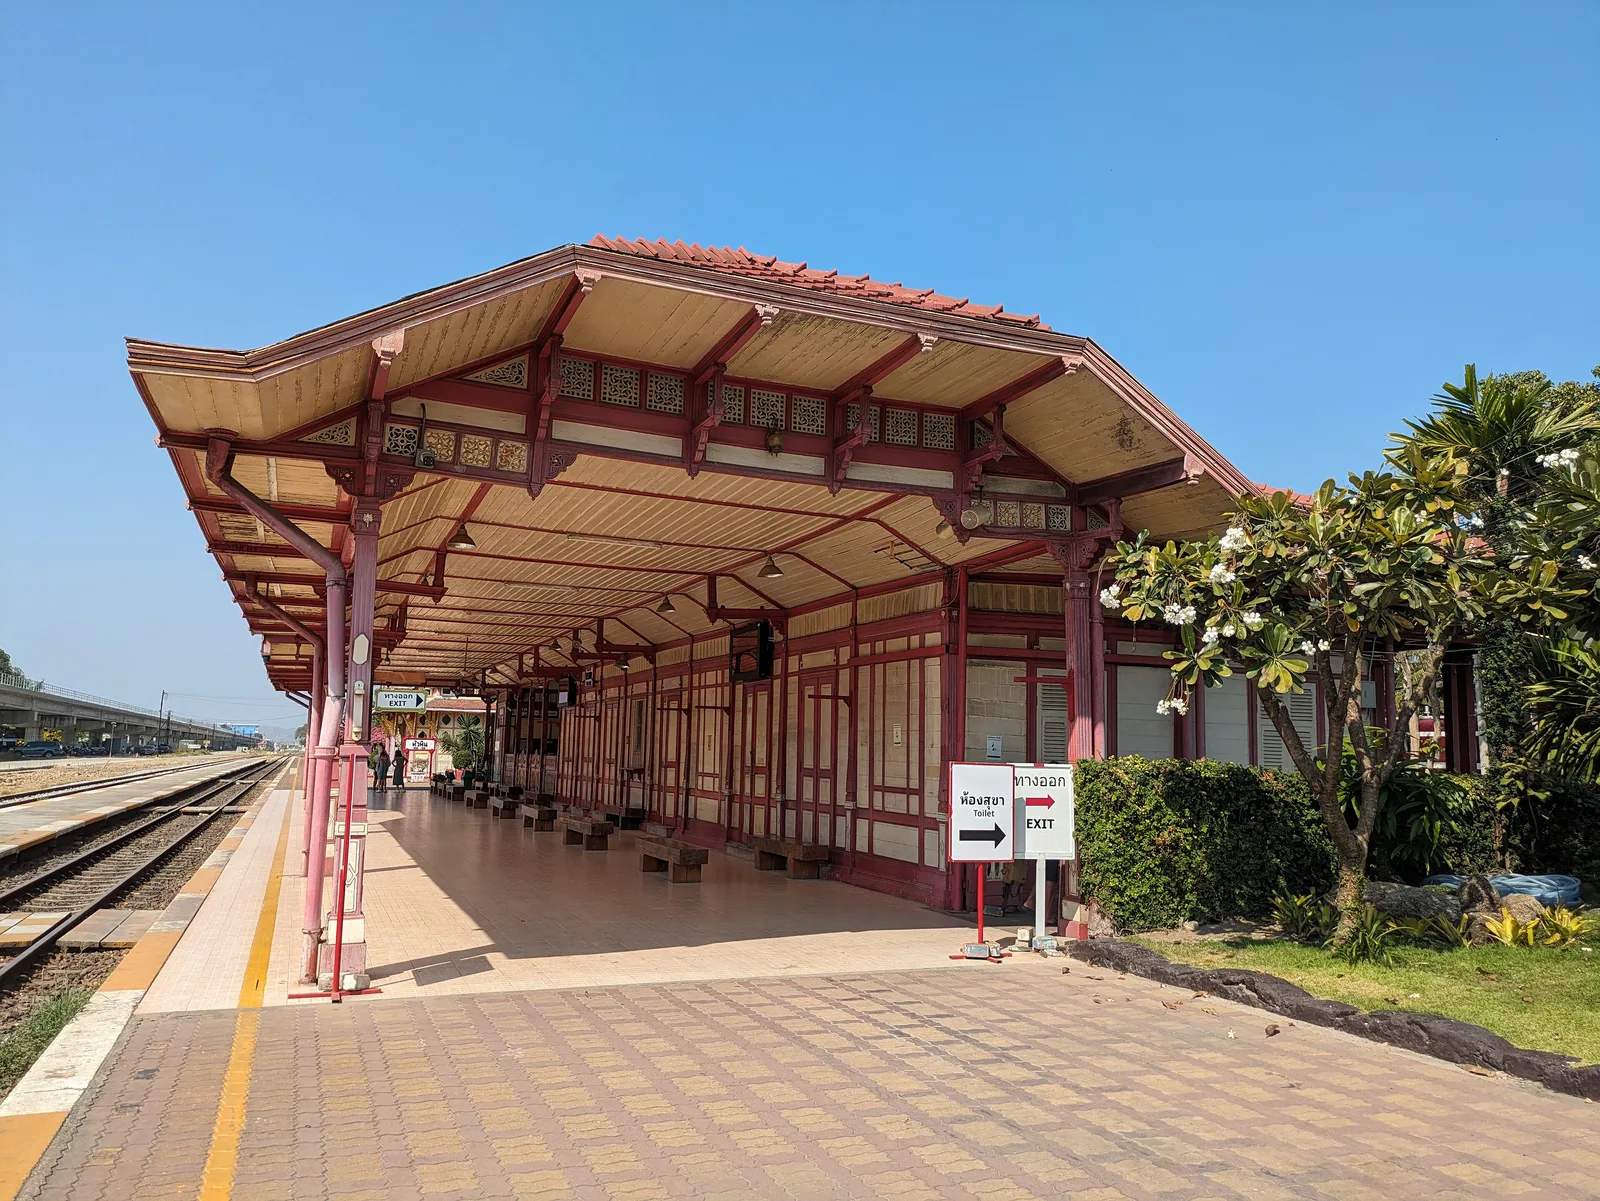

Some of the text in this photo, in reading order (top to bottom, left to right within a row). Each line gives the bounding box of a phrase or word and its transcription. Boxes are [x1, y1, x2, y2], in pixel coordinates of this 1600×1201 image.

[1015, 776, 1066, 787] ทางออก
[960, 791, 1005, 810] ห้องสุขา
[1026, 819, 1055, 829] EXIT
